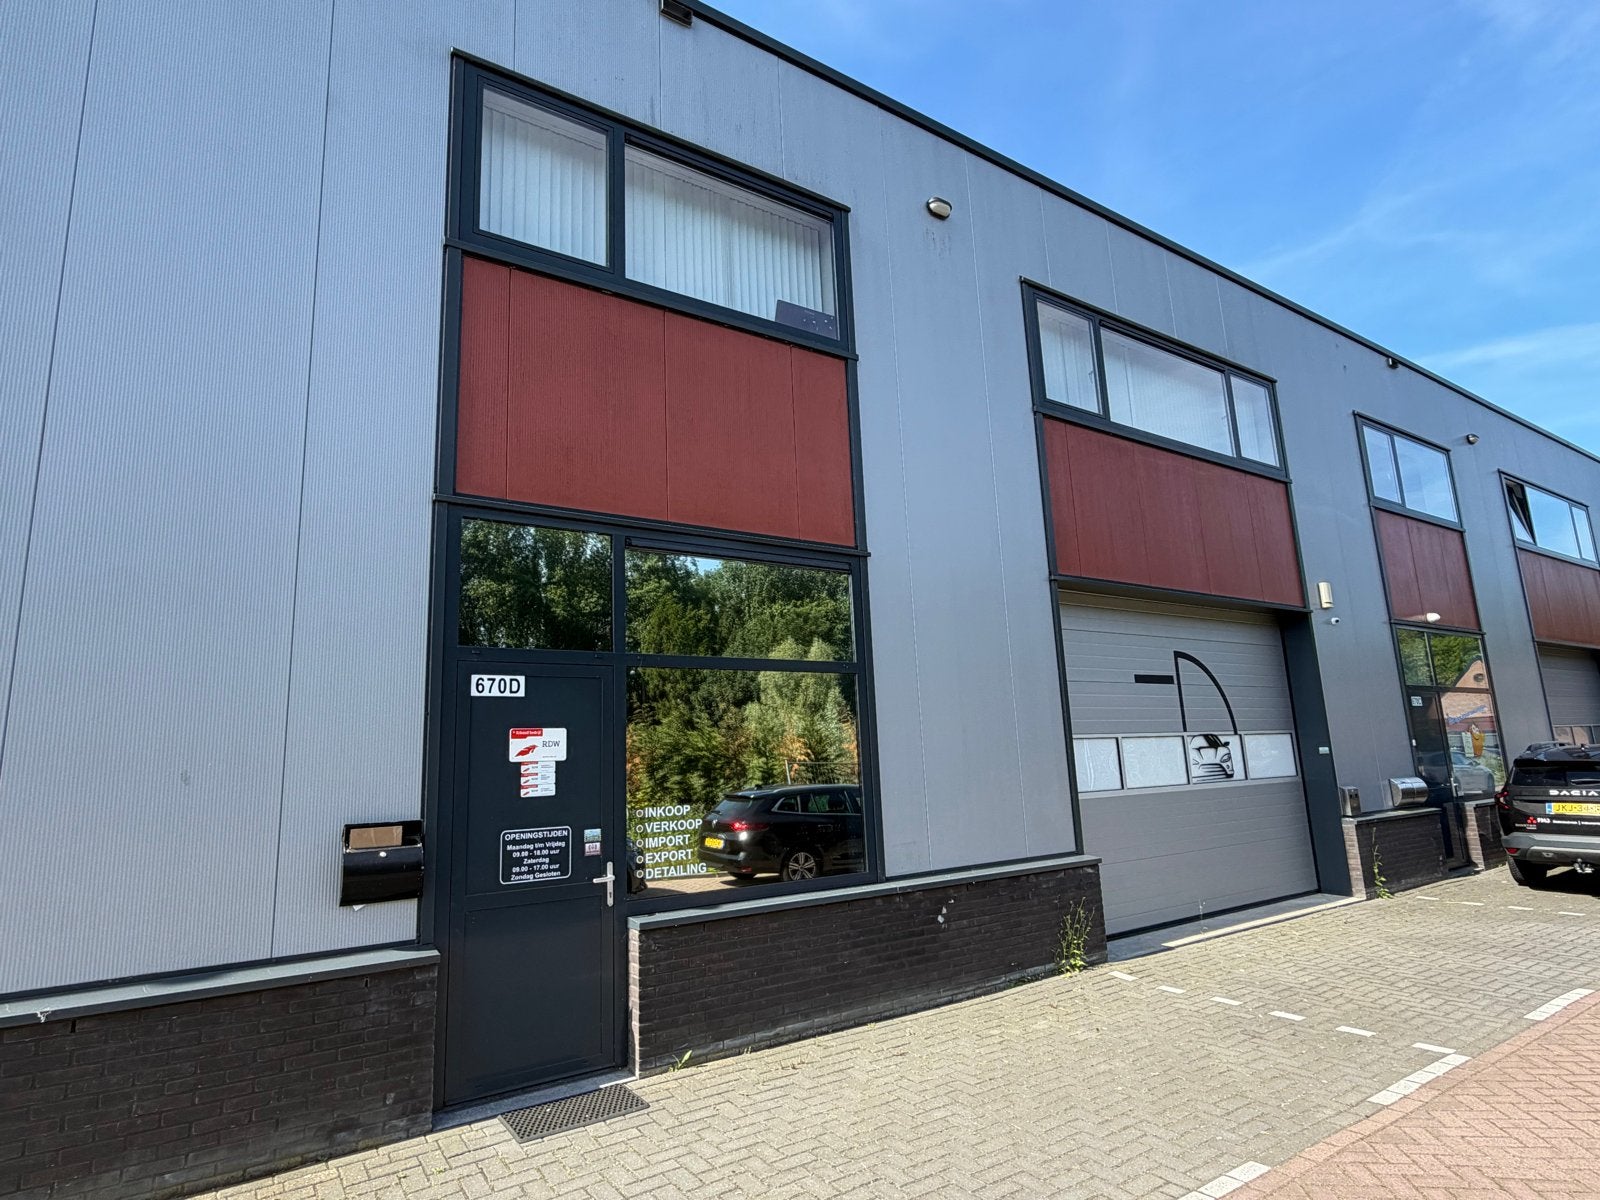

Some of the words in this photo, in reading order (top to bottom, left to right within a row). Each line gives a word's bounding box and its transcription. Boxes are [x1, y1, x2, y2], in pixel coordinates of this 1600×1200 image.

[475, 677, 520, 694] 670D
[542, 740, 560, 748] RDW
[645, 805, 691, 818] INKOOP
[645, 818, 703, 833] VERKOOP
[504, 829, 568, 841] OPENINGSTIJDEN
[645, 834, 691, 849] IMPORT
[645, 849, 693, 864] EXPORT
[645, 863, 707, 879] DETAILING
